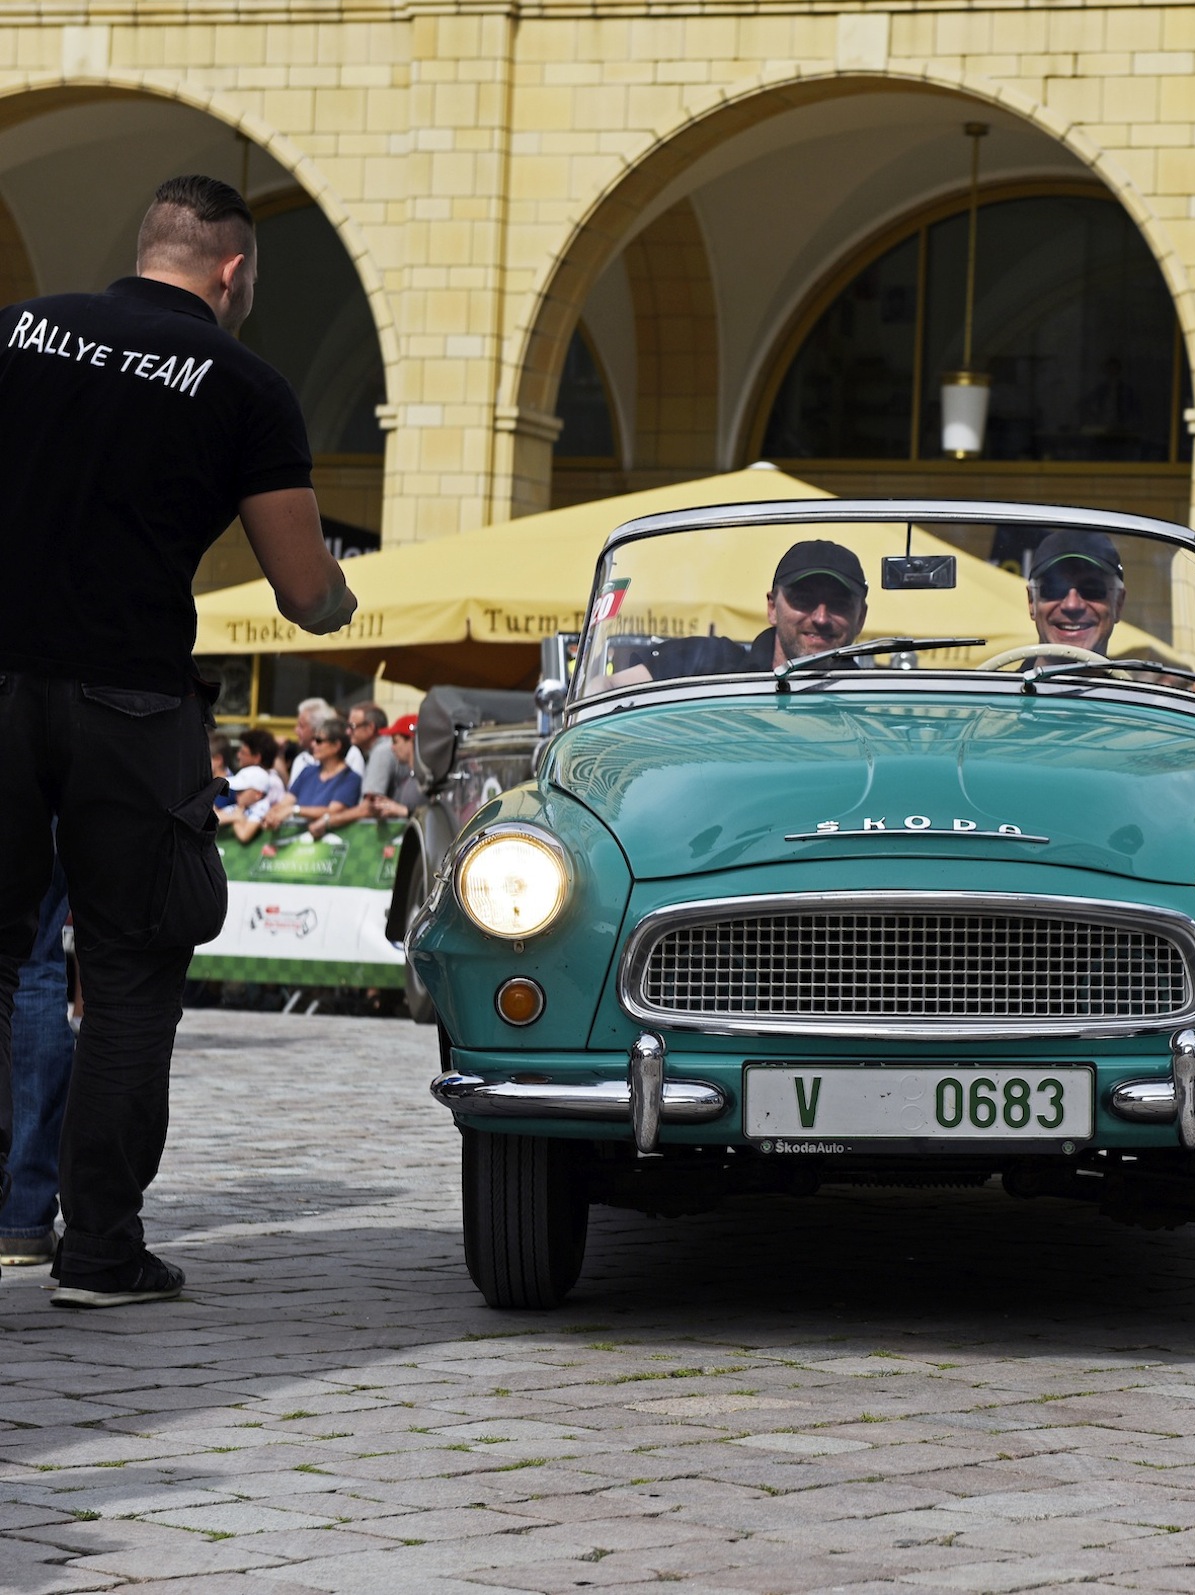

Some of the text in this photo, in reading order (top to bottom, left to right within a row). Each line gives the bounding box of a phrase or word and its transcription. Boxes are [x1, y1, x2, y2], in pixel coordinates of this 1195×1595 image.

[8, 311, 213, 397] RALLYE TEAM
[226, 617, 297, 643] Theke
[816, 815, 1022, 834] ŠKODA
[794, 1077, 1064, 1129] V 0683
[775, 1139, 844, 1153] ŠkodaAuto
